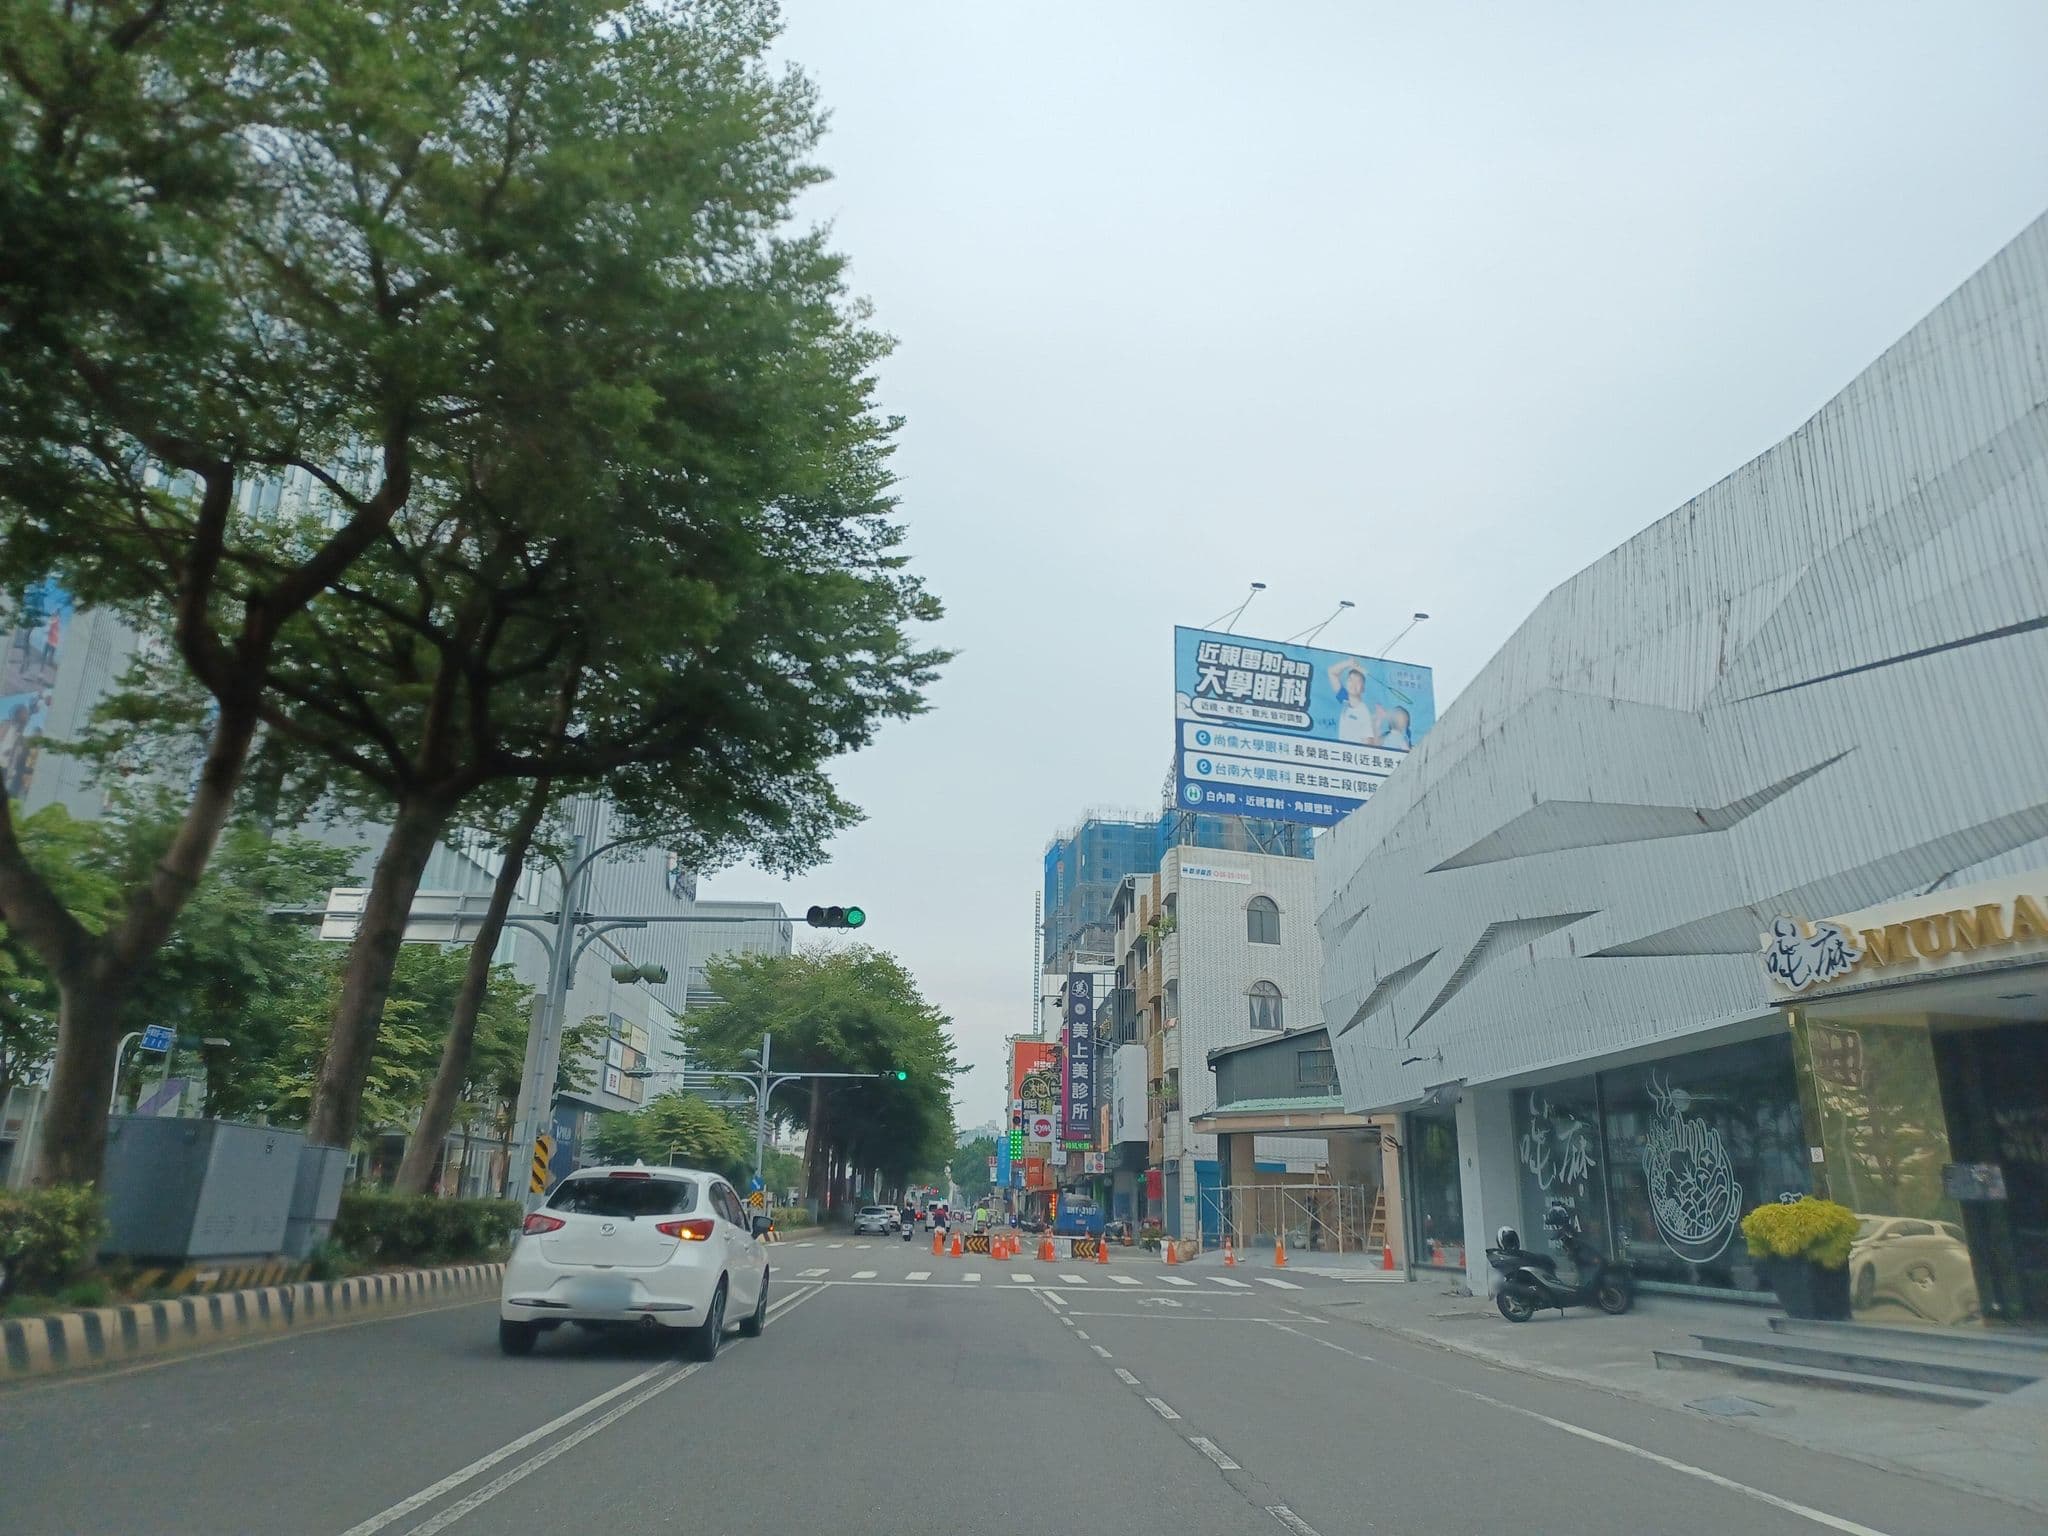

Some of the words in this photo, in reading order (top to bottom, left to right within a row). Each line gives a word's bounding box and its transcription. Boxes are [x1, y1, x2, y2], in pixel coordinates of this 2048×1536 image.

[1196, 667, 1308, 706] 大學眼科
[1215, 762, 1291, 783] 台南大學眼科
[1072, 1022, 1089, 1120] 美上美診所
[1033, 1123, 1052, 1134] SYM
